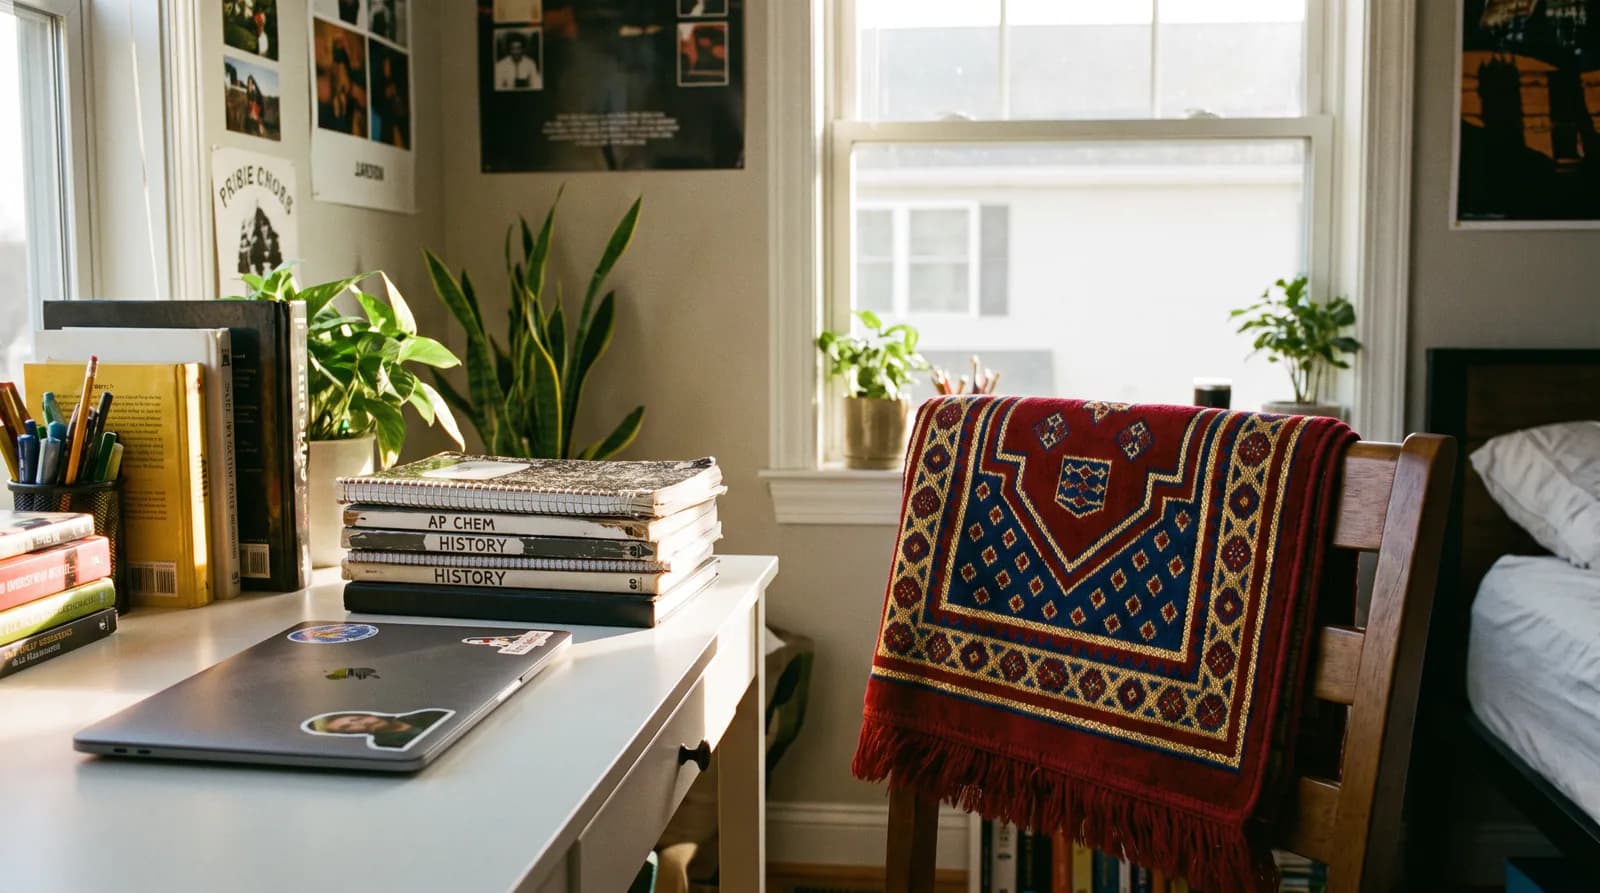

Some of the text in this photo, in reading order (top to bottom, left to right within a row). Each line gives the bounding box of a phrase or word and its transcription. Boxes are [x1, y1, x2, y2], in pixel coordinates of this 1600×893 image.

[428, 514, 496, 531] AP CHEM
[439, 536, 507, 553] HISTORY
[434, 568, 506, 586] HISTORY
